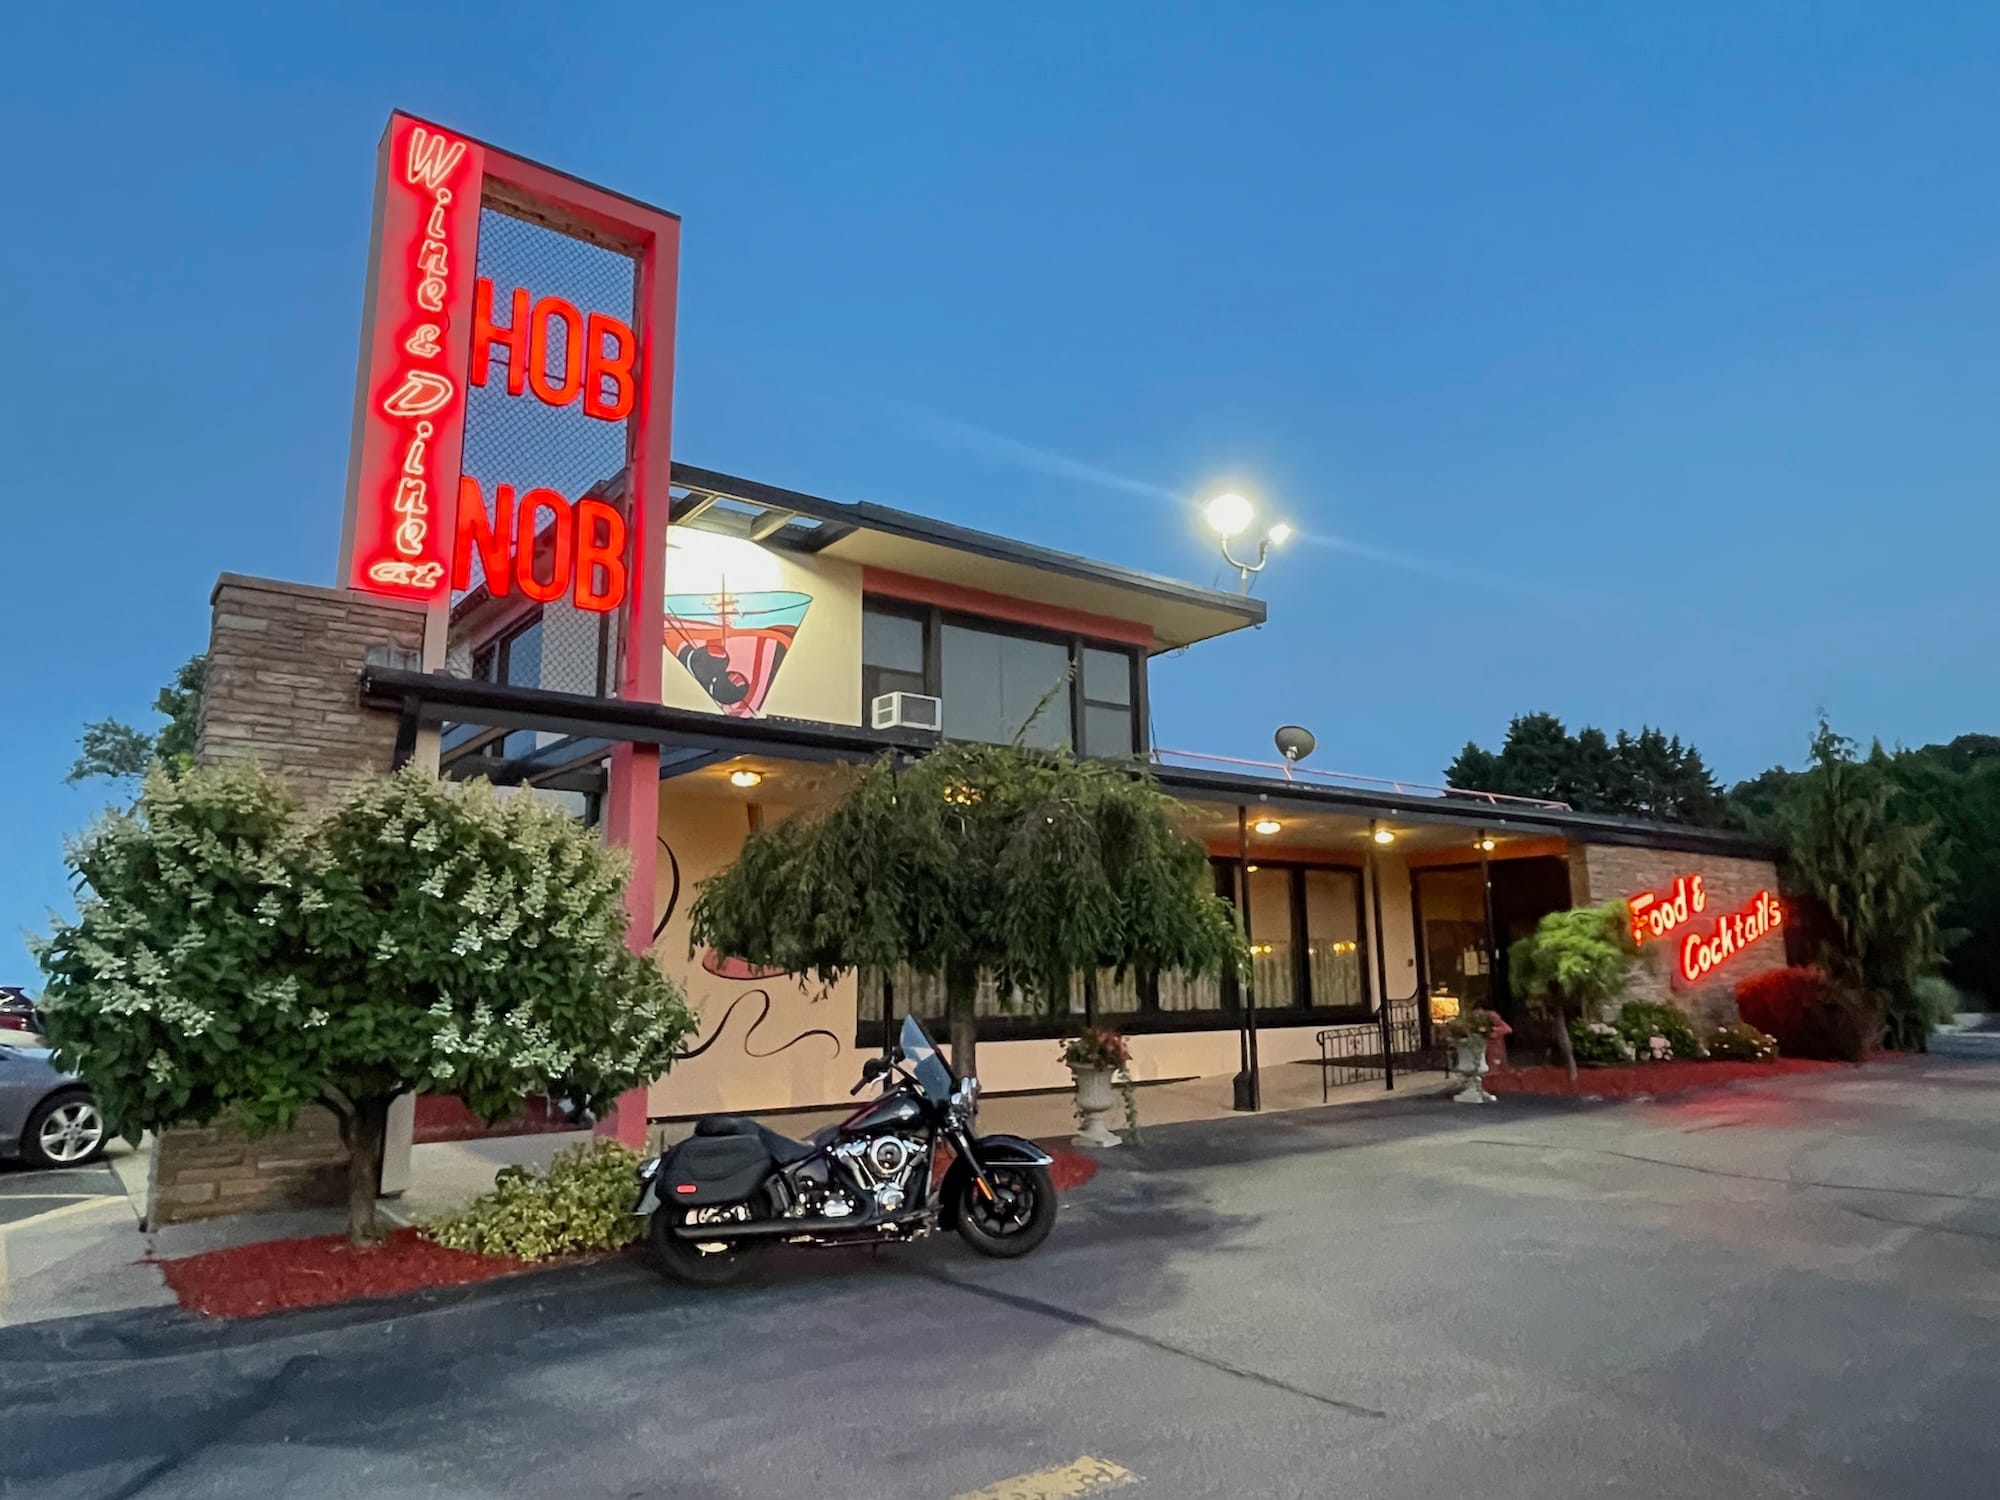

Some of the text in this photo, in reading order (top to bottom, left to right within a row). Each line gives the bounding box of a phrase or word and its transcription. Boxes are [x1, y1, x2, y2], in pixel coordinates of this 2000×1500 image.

[369, 127, 466, 588] Wine & Dine at
[469, 277, 637, 421] HOB
[451, 475, 626, 613] NOB
[1629, 877, 1688, 947] Food
[1681, 890, 1783, 981] Cocktails
